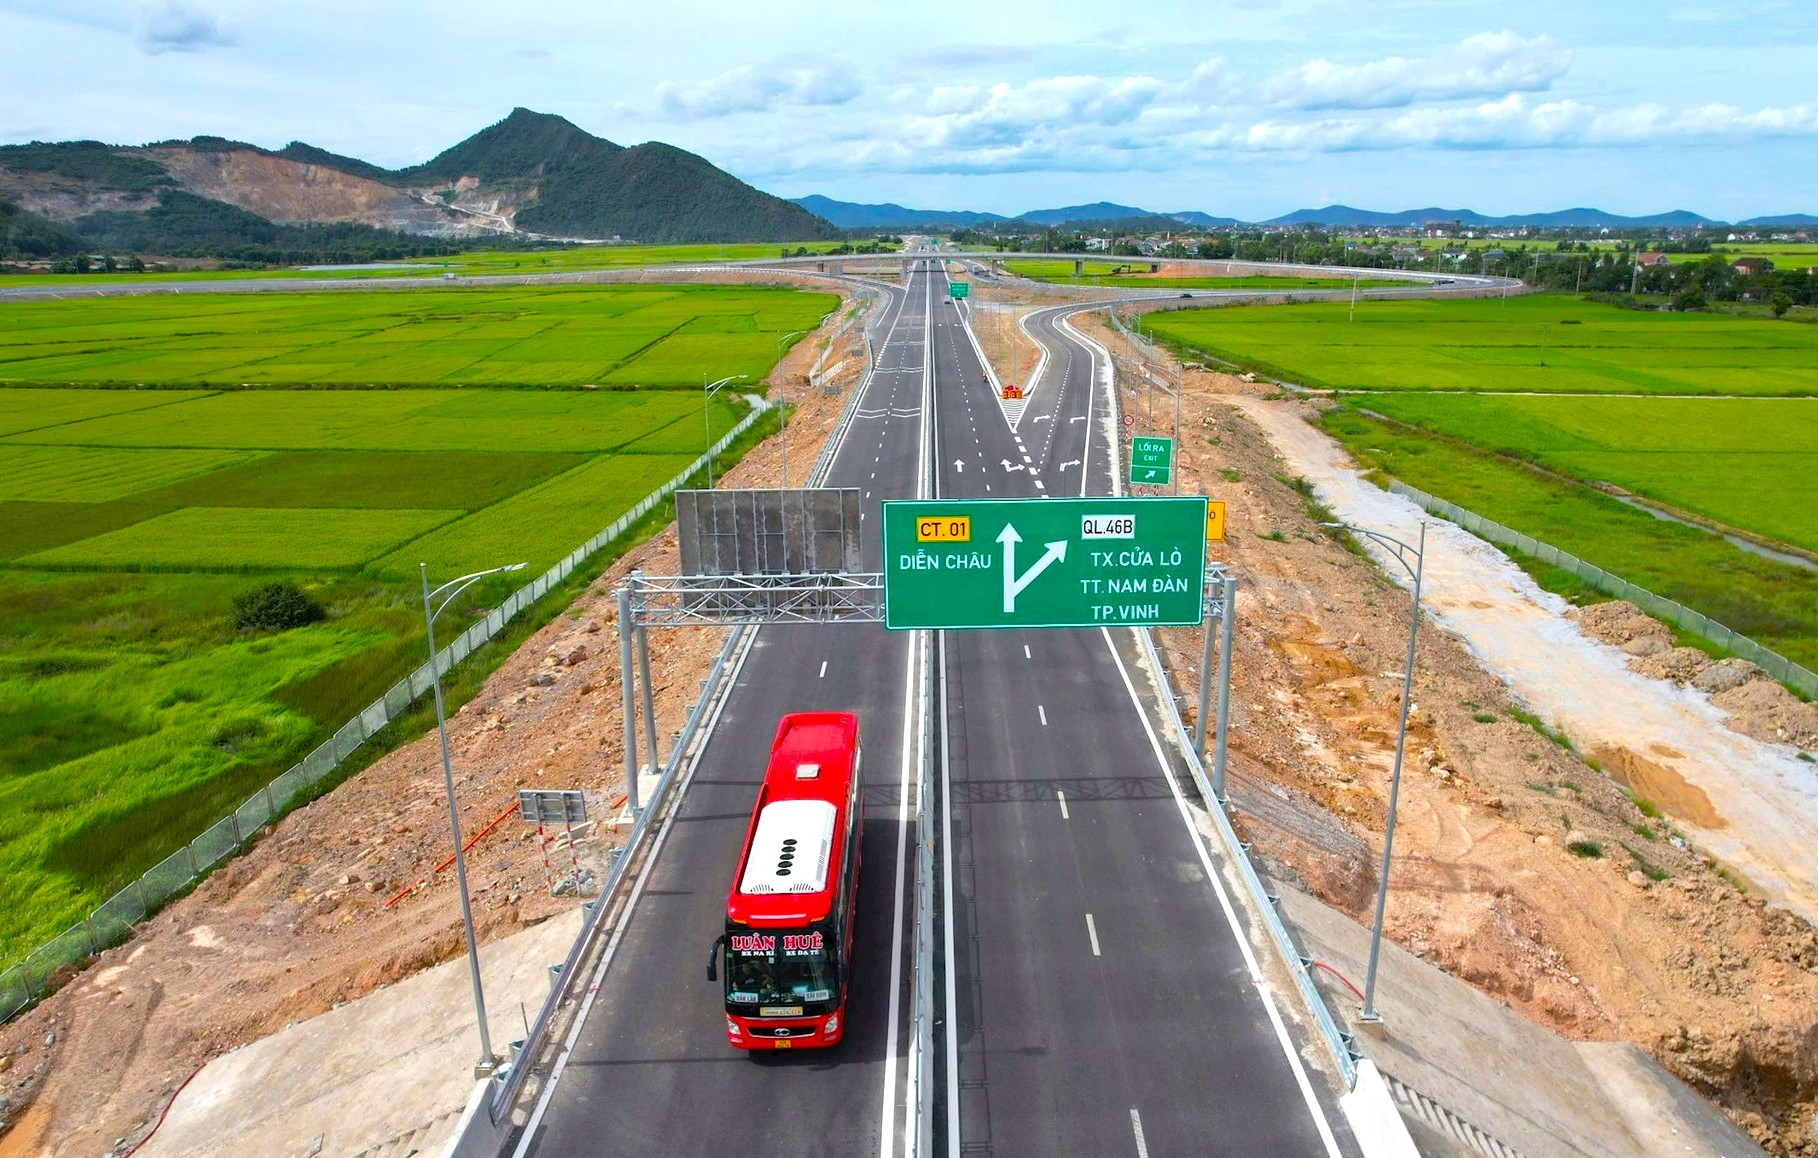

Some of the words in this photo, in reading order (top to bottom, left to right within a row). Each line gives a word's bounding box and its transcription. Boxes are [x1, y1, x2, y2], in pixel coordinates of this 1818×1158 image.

[1153, 444, 1165, 452] RA
[949, 522, 965, 536] 01
[1083, 519, 1133, 535] QL.46B
[900, 548, 939, 570] DIỄN
[945, 551, 991, 569] CHÂU
[1160, 546, 1182, 566] LÒ
[1152, 574, 1188, 593] ĐÀN
